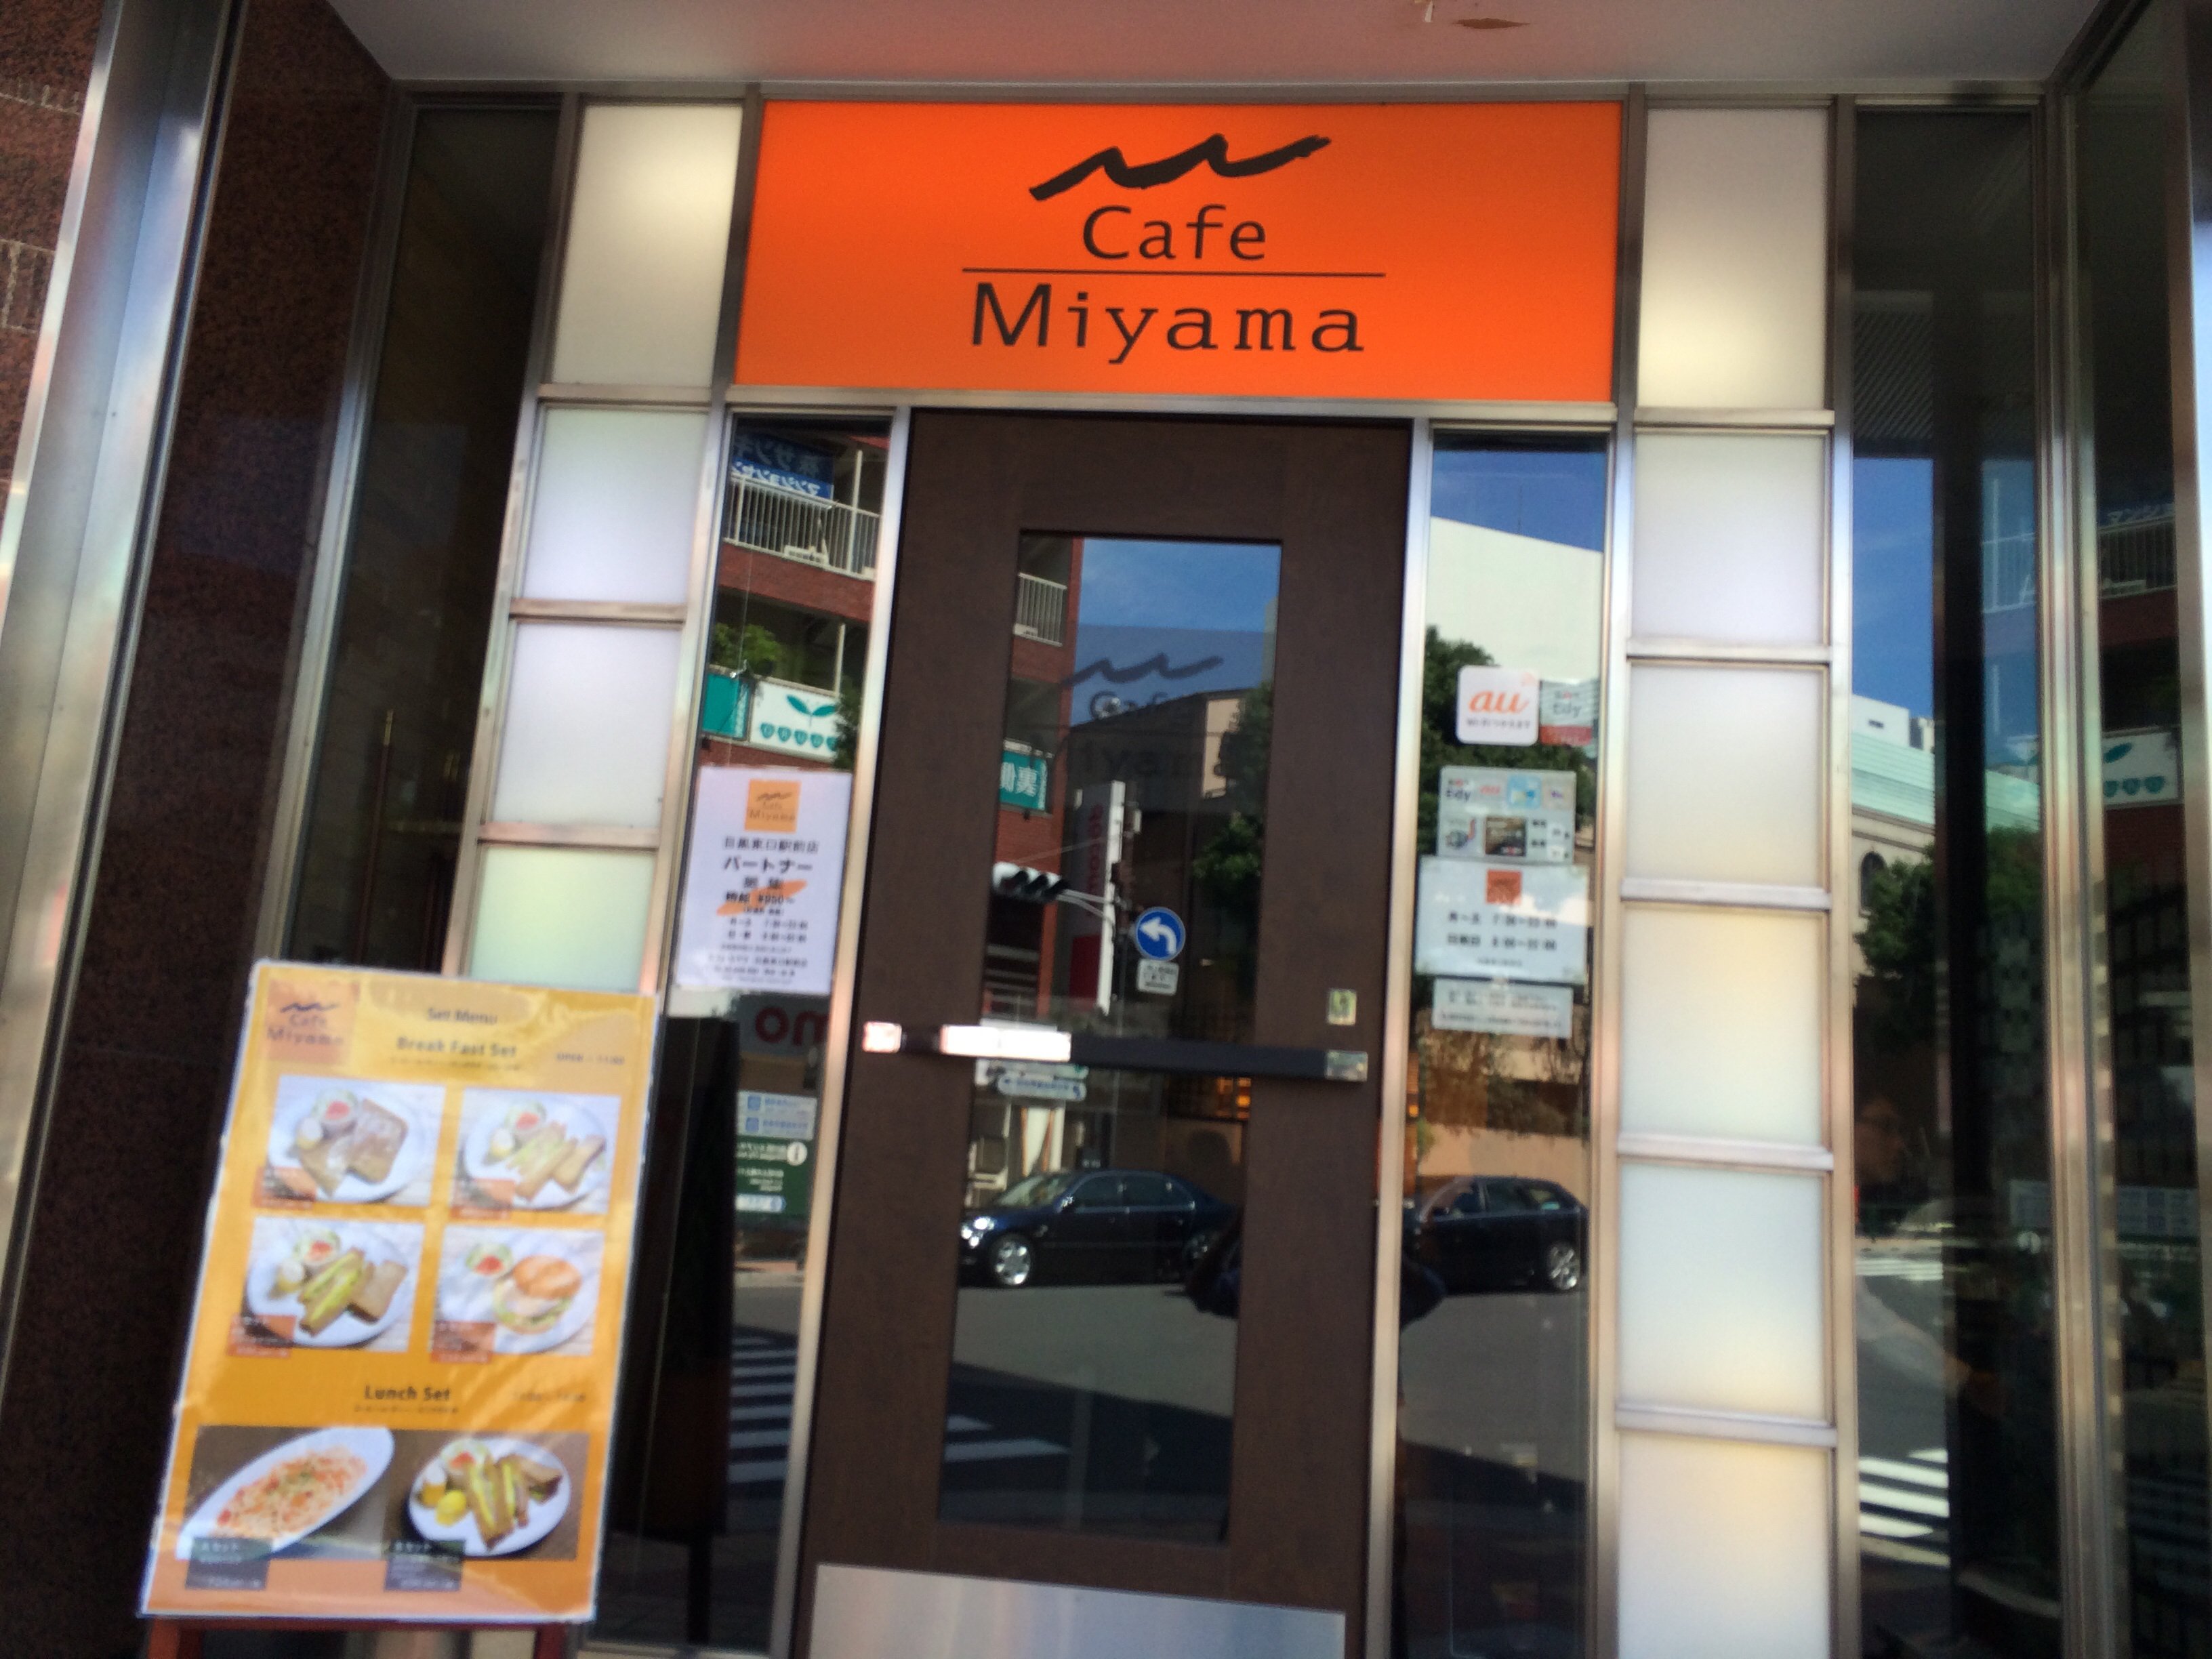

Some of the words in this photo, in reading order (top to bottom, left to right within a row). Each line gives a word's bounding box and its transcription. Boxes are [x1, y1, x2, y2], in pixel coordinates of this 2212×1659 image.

[1083, 204, 1266, 260] Cafe
[971, 282, 1365, 364] Miyama
[1469, 690, 1530, 714] au
[724, 856, 813, 874] パートナー
[428, 1008, 451, 1021] Set
[455, 1010, 498, 1025] Menu
[398, 1036, 445, 1051] Break
[491, 1043, 516, 1057] Set
[365, 1385, 417, 1399] Lunch
[423, 1386, 450, 1401] Set
